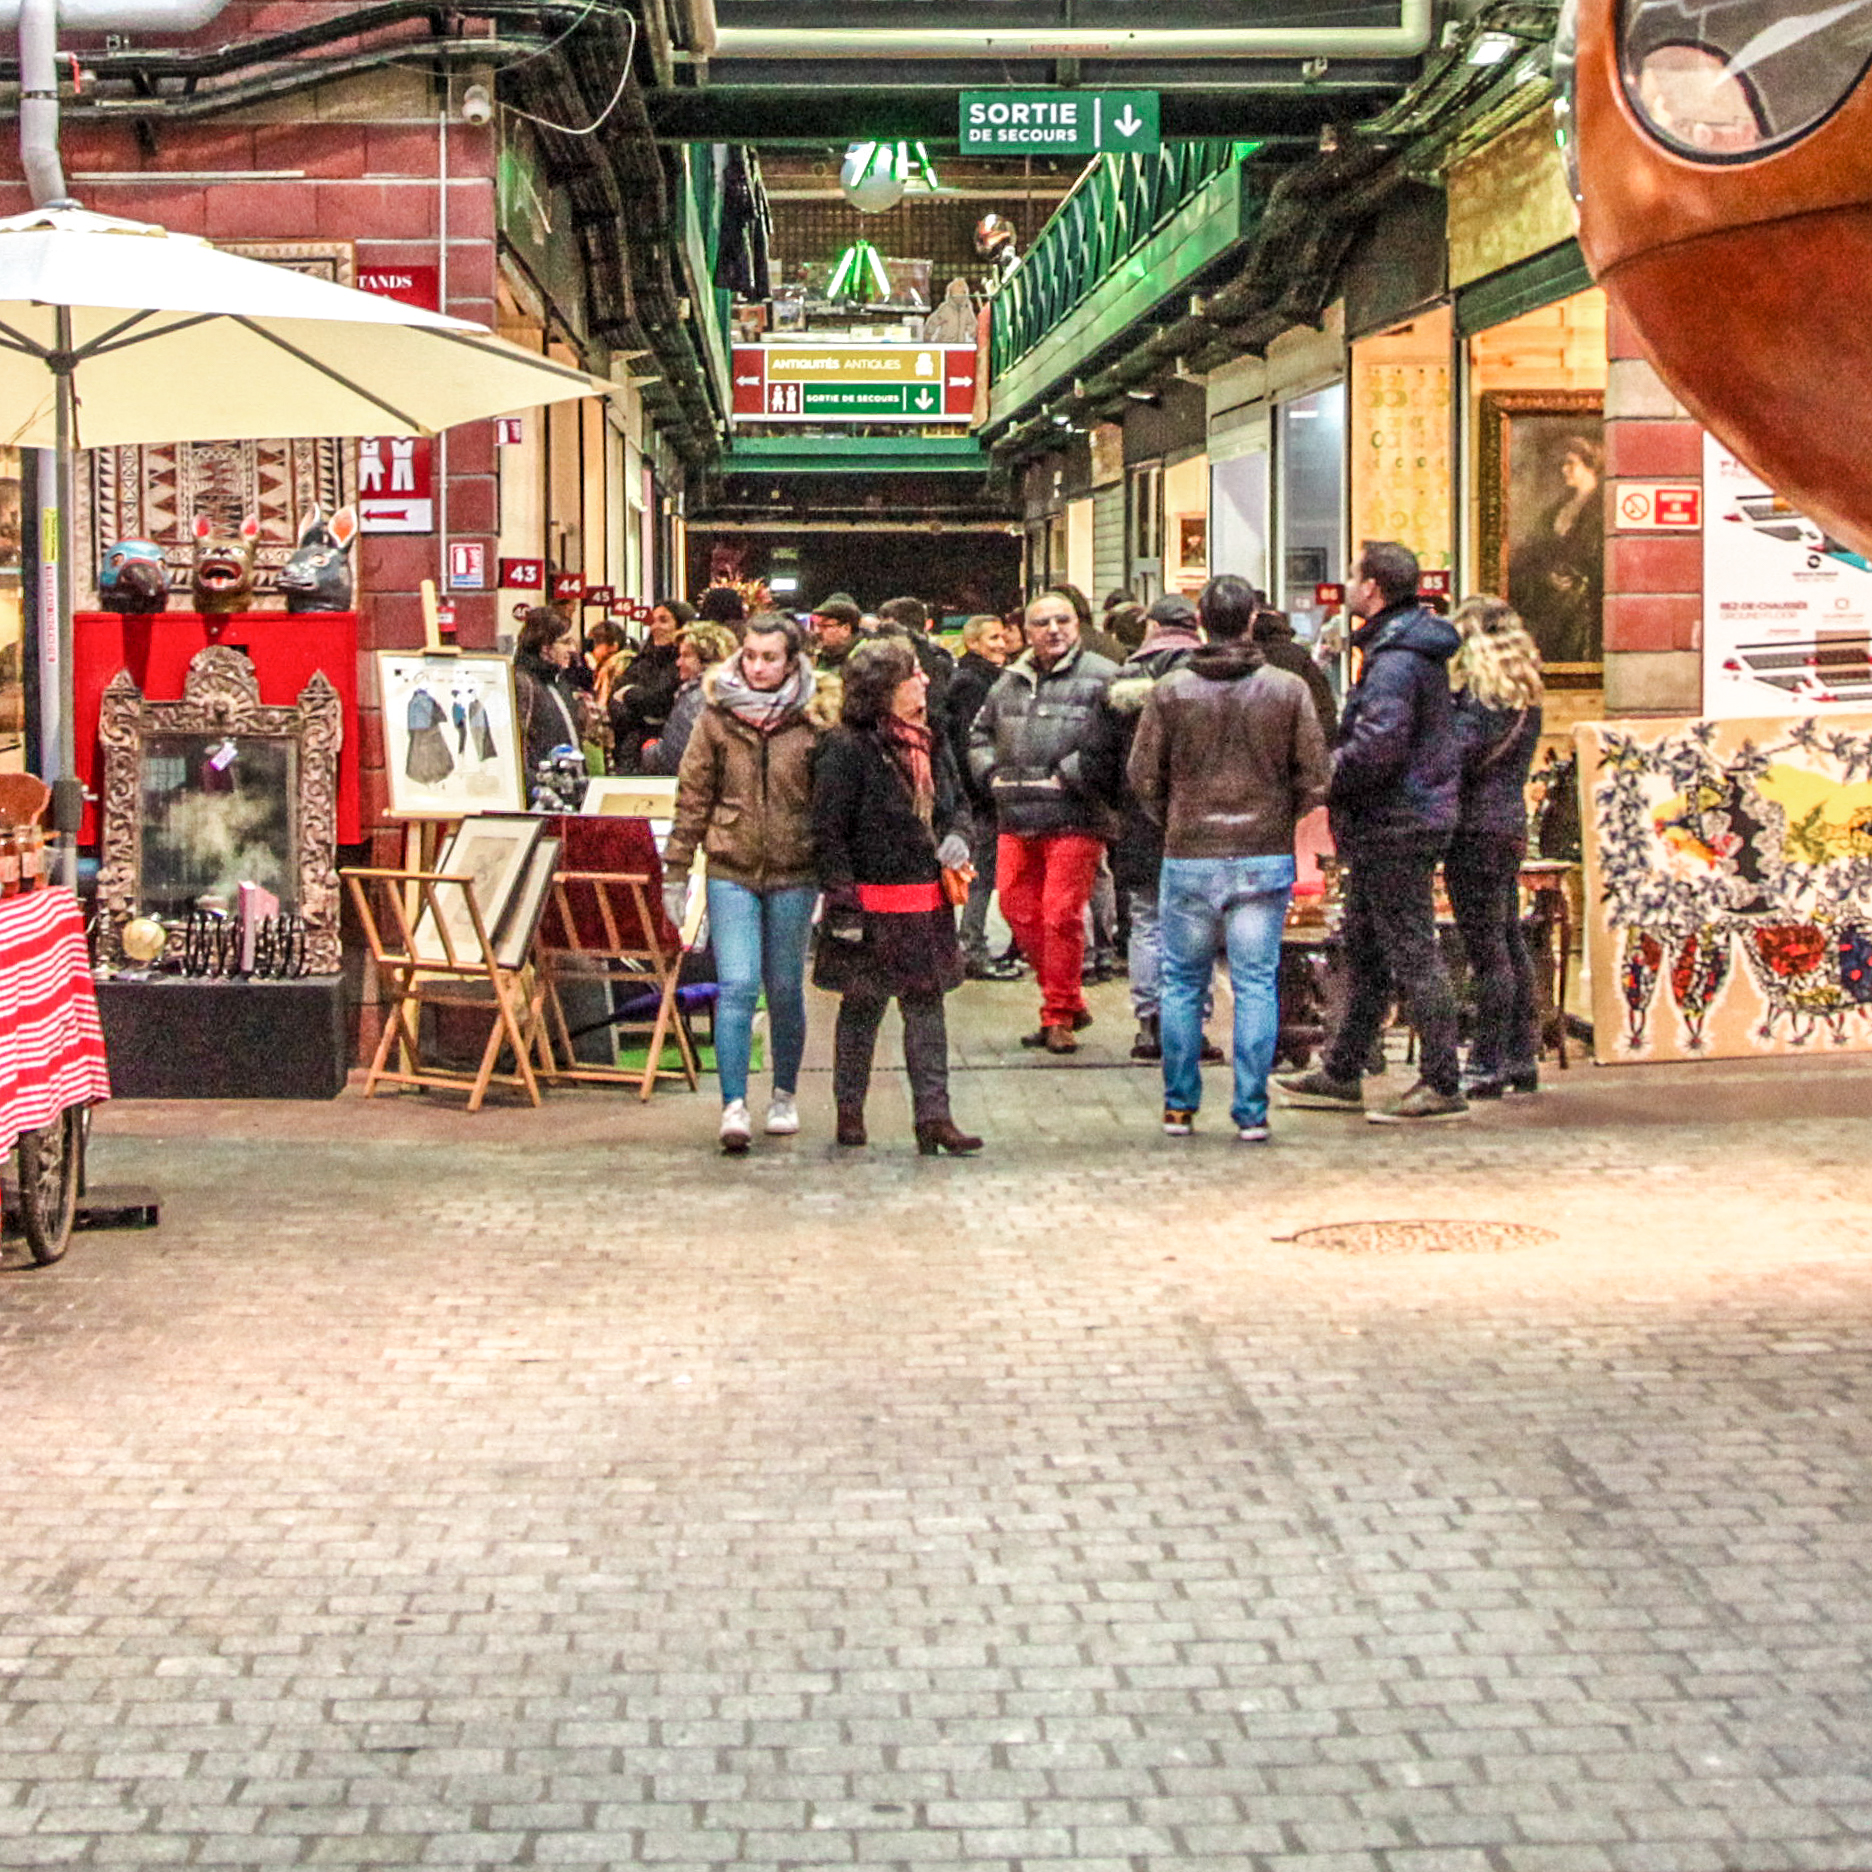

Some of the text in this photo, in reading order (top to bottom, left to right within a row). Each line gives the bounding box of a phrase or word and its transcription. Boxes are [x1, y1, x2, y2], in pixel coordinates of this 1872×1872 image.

[968, 102, 1078, 125] SORTIE
[968, 128, 1078, 142] DE SECOURS
[357, 274, 414, 289] TANDS
[771, 356, 902, 370] ANTIQUITÉS ANTIQUES
[805, 393, 900, 403] SORTIE DE SECOURS
[509, 564, 538, 584] 43
[558, 579, 582, 593] 44
[1421, 574, 1444, 590] 85
[591, 591, 611, 604] 45
[633, 608, 647, 620] 47
